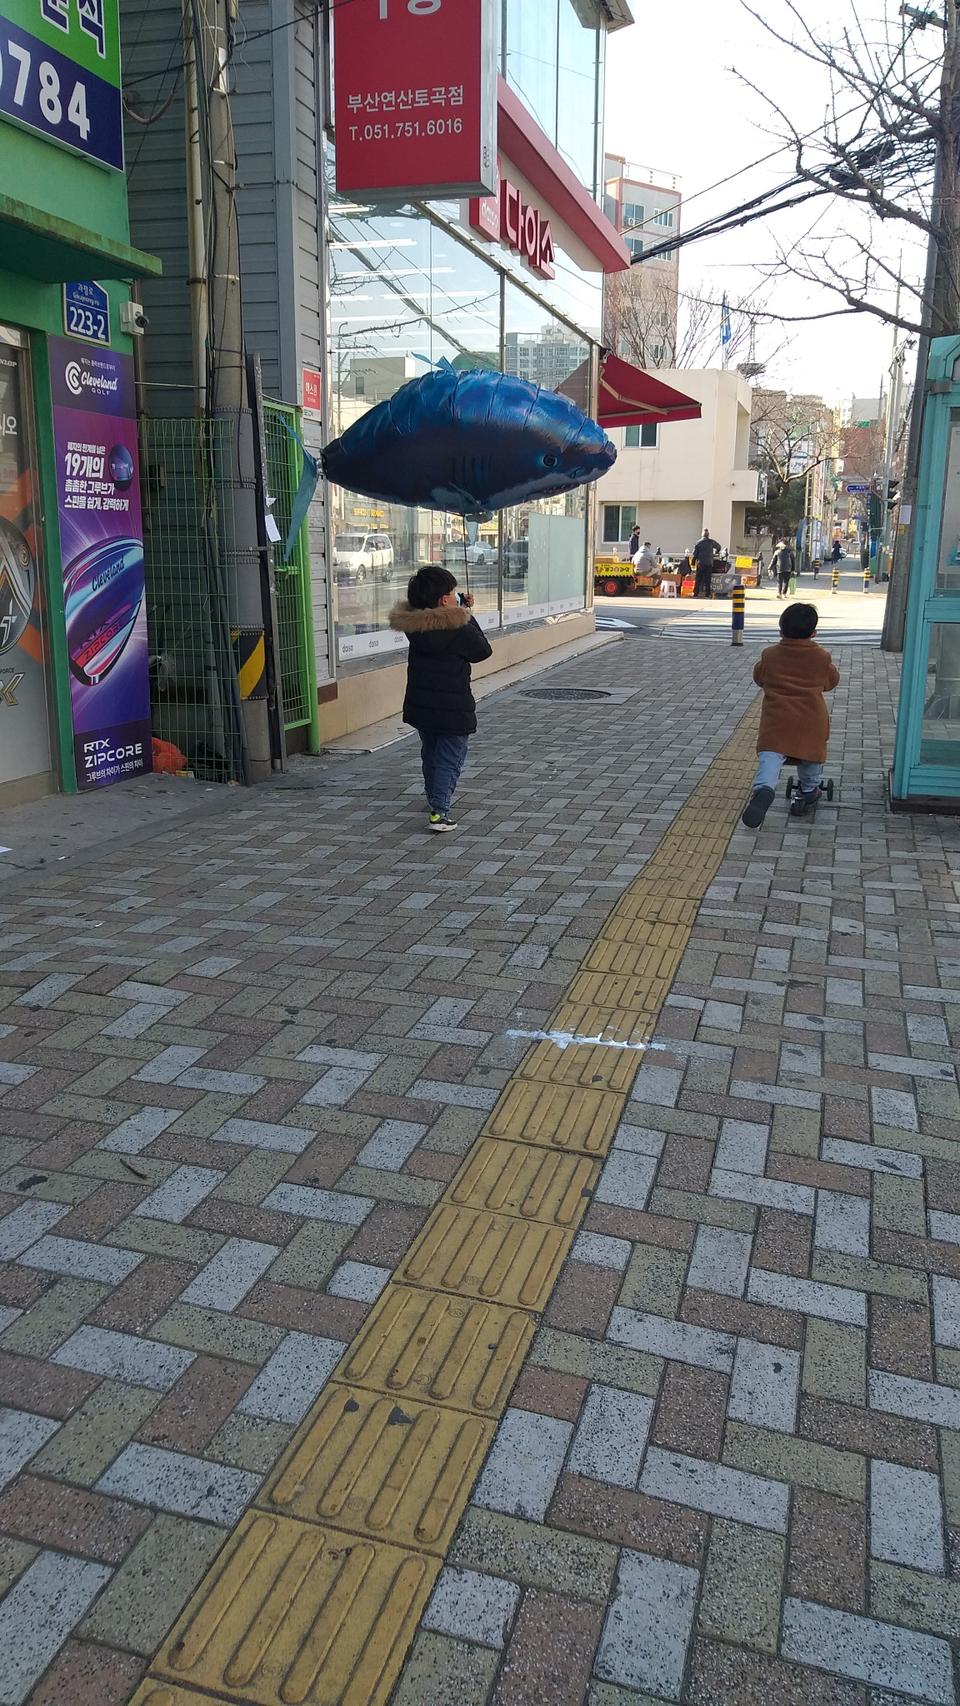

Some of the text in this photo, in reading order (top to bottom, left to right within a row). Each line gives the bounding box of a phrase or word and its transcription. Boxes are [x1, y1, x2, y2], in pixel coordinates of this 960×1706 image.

[0, 39, 90, 140] 784
[347, 85, 464, 114] 부산연산토곡점
[349, 118, 462, 141] T.051.751.6016
[505, 179, 555, 279] 다이소
[69, 306, 106, 339] 223-2
[81, 371, 118, 391] Cleveland
[91, 387, 110, 396] GOLF
[64, 452, 104, 479] 19개의
[87, 480, 115, 495] 그루브가
[64, 495, 86, 509] 스핀을
[102, 497, 129, 511] 강력하게
[91, 555, 125, 591] Cleveland
[84, 737, 110, 753] RTX
[84, 743, 143, 768] ZIPCORE
